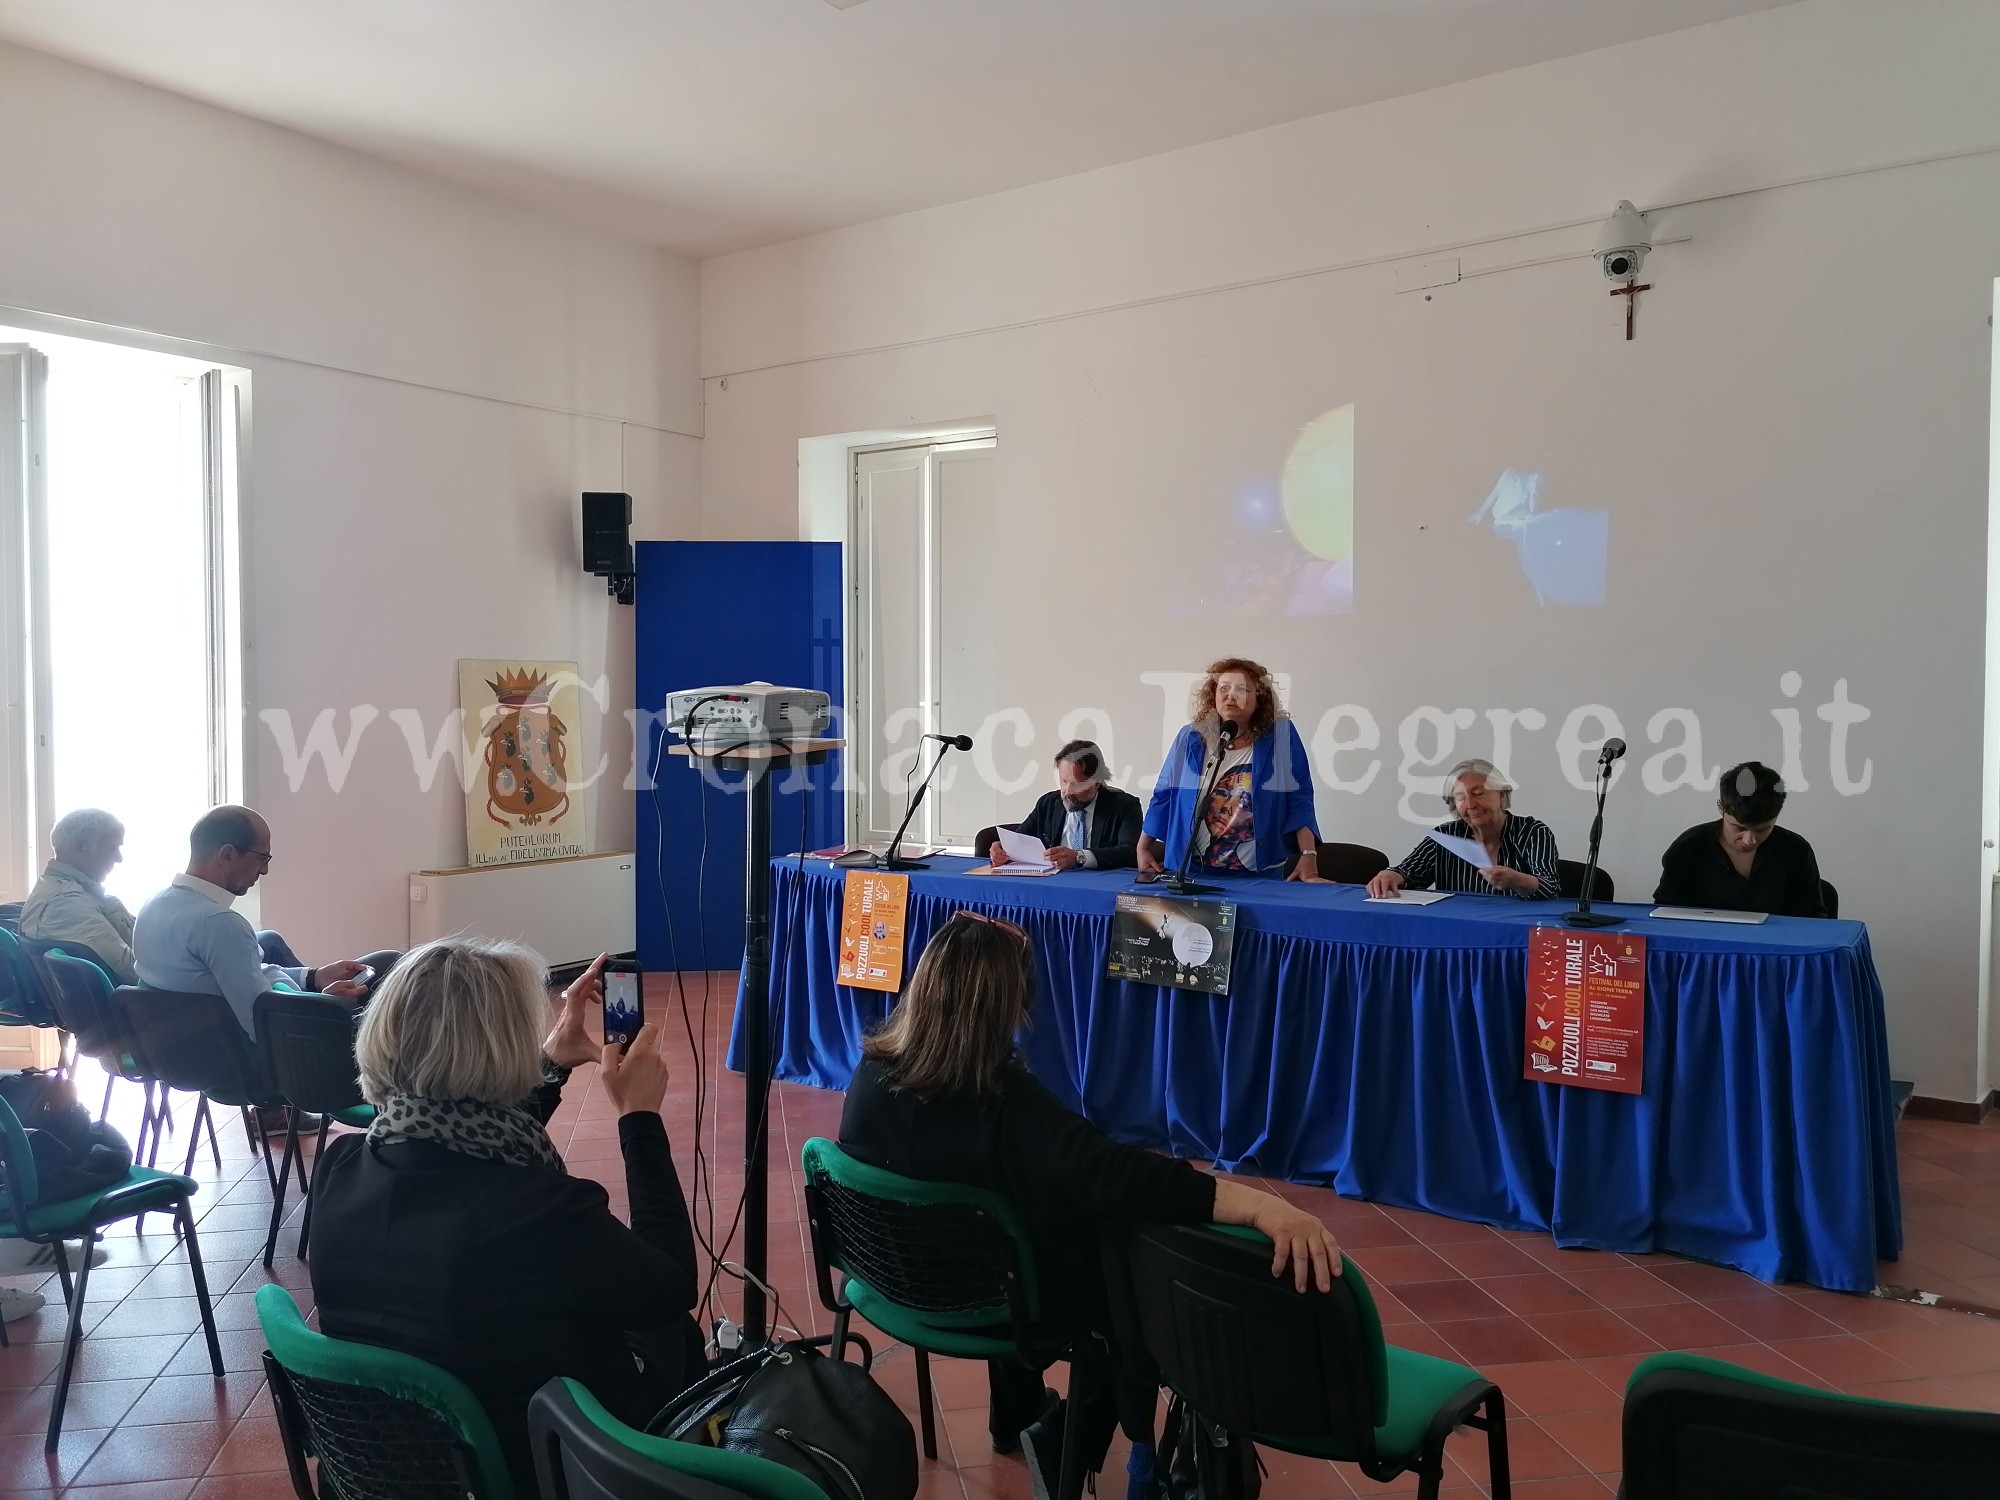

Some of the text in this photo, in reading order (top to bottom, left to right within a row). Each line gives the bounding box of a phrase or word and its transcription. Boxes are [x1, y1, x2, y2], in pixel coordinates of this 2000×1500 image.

[500, 833, 561, 849] PUTEOLORUM
[510, 846, 559, 861] FIDELISSIMA
[1588, 977, 1640, 989] FESTIVAL DEL LIBRO
